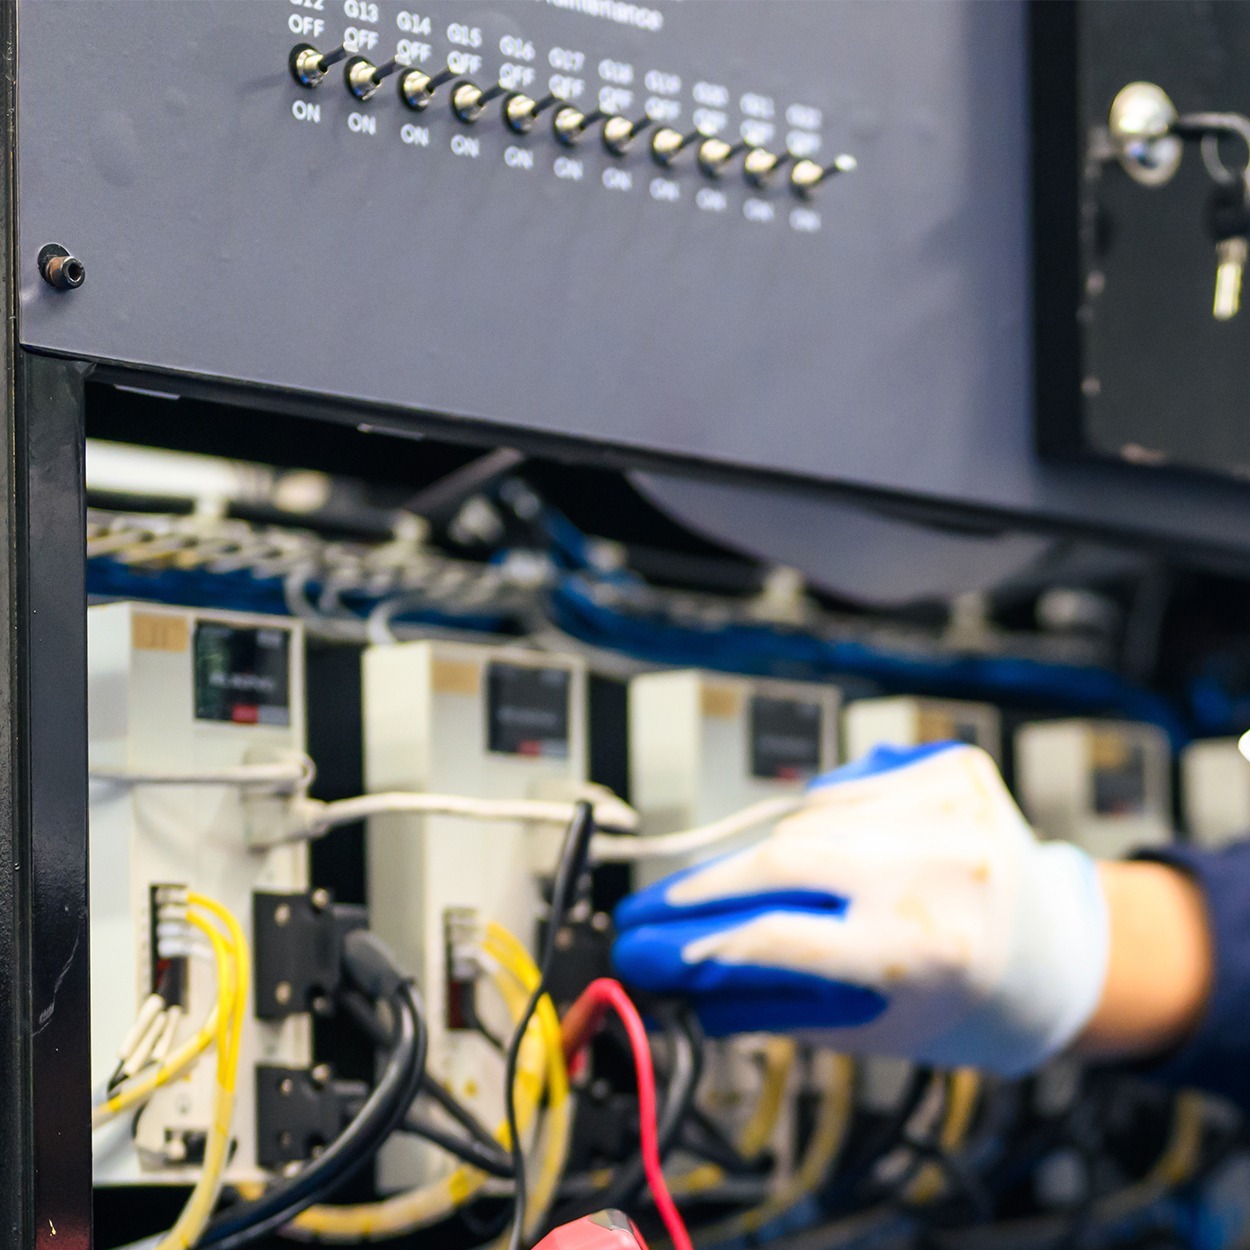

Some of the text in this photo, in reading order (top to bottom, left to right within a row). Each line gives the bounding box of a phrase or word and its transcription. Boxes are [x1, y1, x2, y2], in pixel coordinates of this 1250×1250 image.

[288, 13, 325, 38] OFF
[344, 26, 379, 50] OFF
[397, 39, 432, 62] OFF
[447, 51, 482, 75] OFF
[499, 63, 535, 87] OFF
[344, 0, 379, 23] G13
[397, 11, 431, 36] G14
[447, 23, 482, 48] G15
[292, 100, 321, 123] ON
[348, 112, 376, 135] ON
[401, 123, 429, 147] ON
[451, 134, 480, 158] ON
[504, 146, 534, 170] ON
[554, 156, 583, 180] ON
[602, 167, 632, 192] ON
